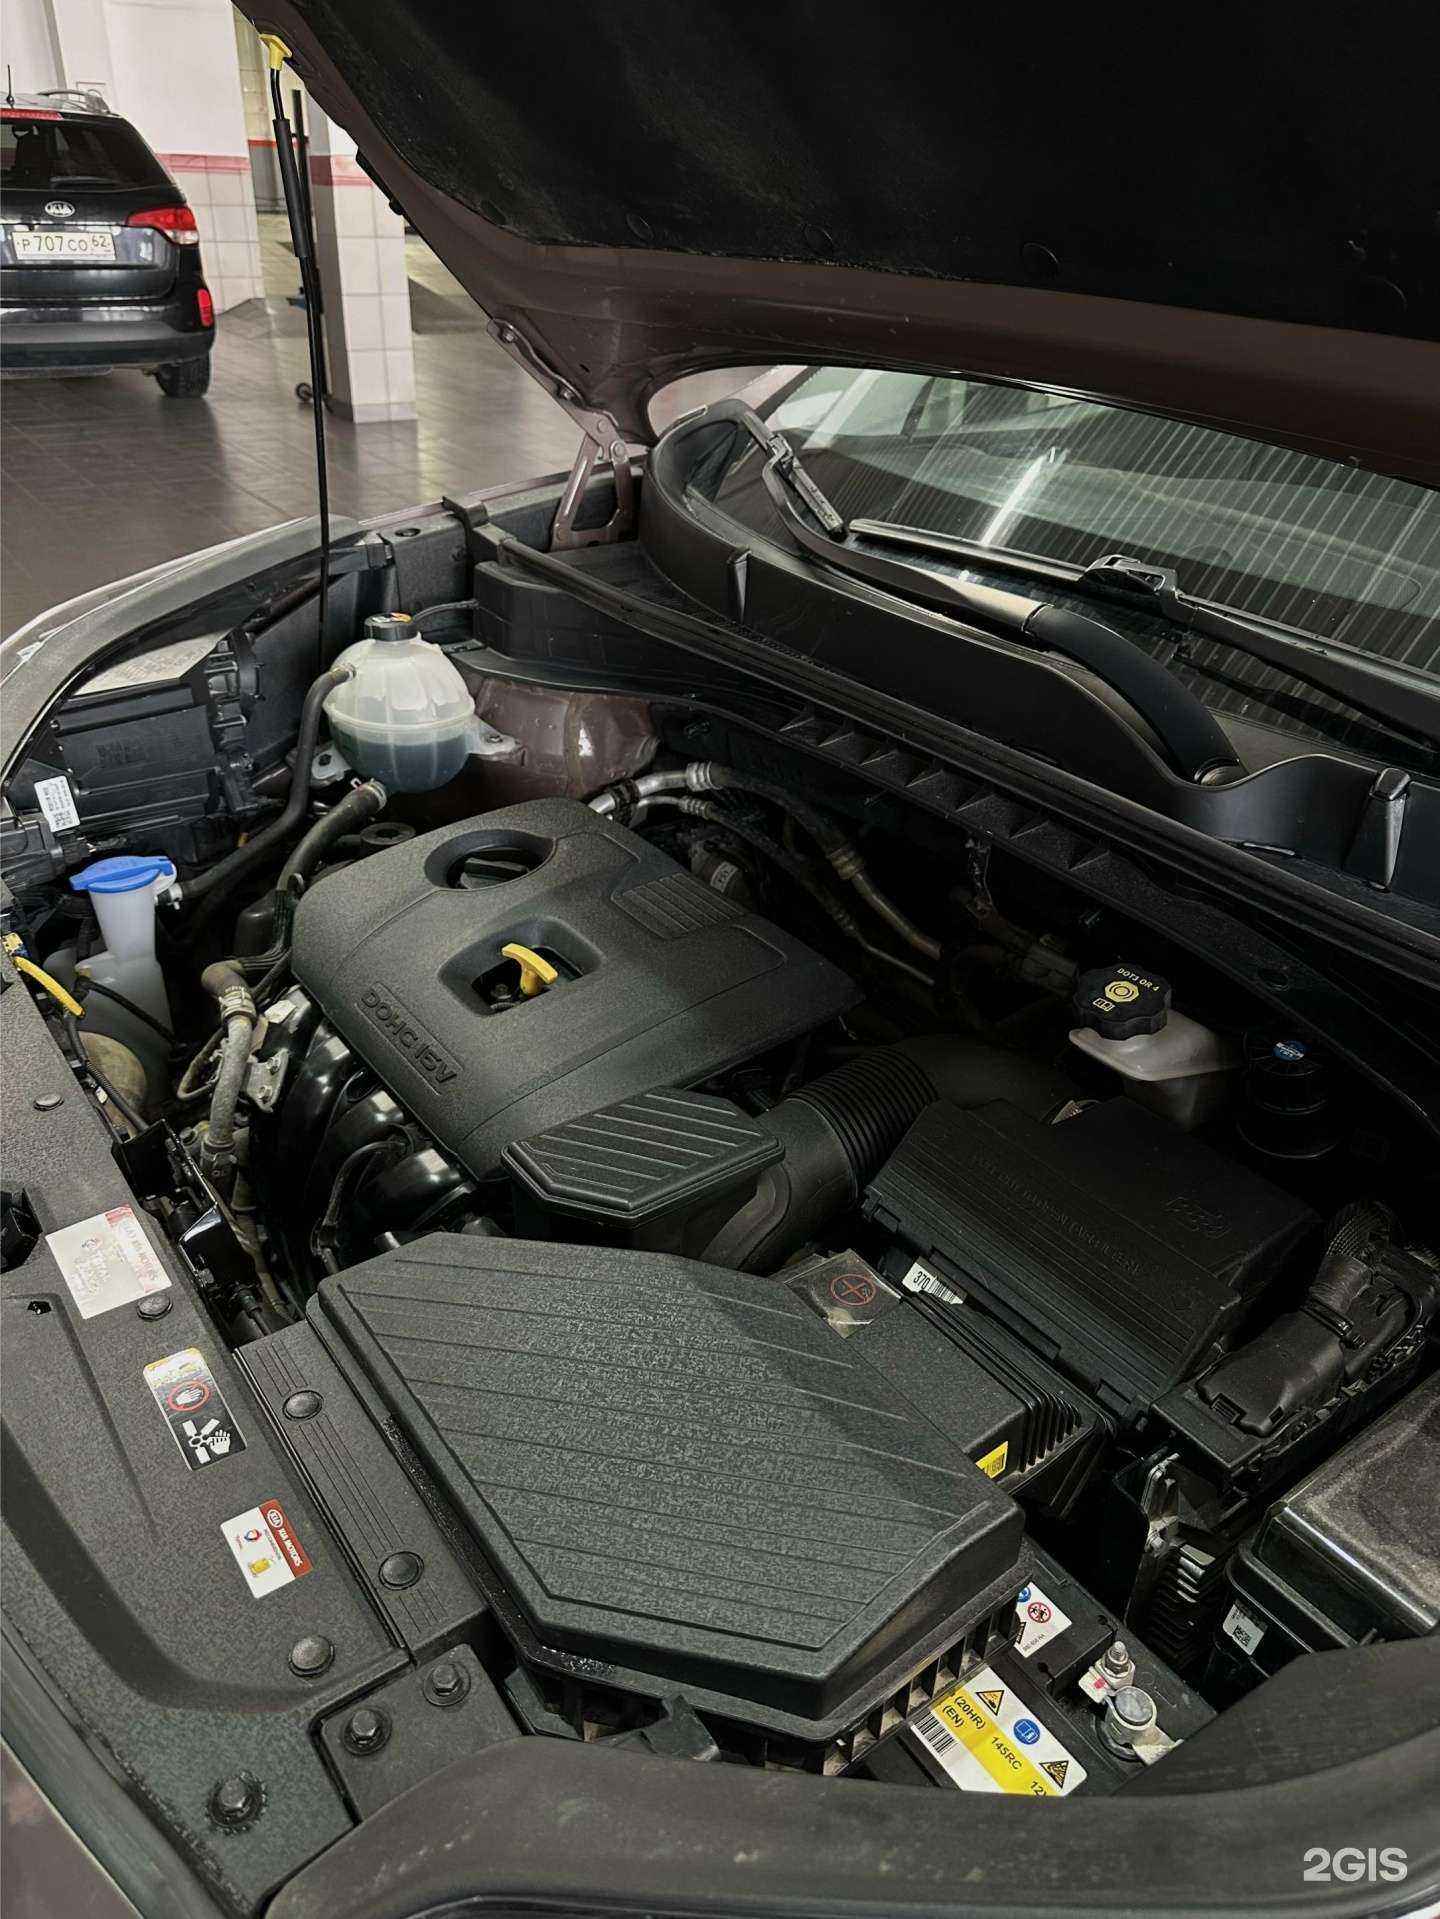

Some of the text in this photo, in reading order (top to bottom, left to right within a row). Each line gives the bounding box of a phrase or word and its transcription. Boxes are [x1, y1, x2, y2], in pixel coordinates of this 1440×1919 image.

[1139, 978, 1154, 989] OR
[361, 989, 419, 1049] DOHC
[912, 1270, 931, 1290] 370
[283, 1539, 304, 1567] MOTORS
[941, 1704, 966, 1729] (EN)
[954, 1695, 987, 1731] (20HR)
[991, 1735, 1023, 1771] 145RC
